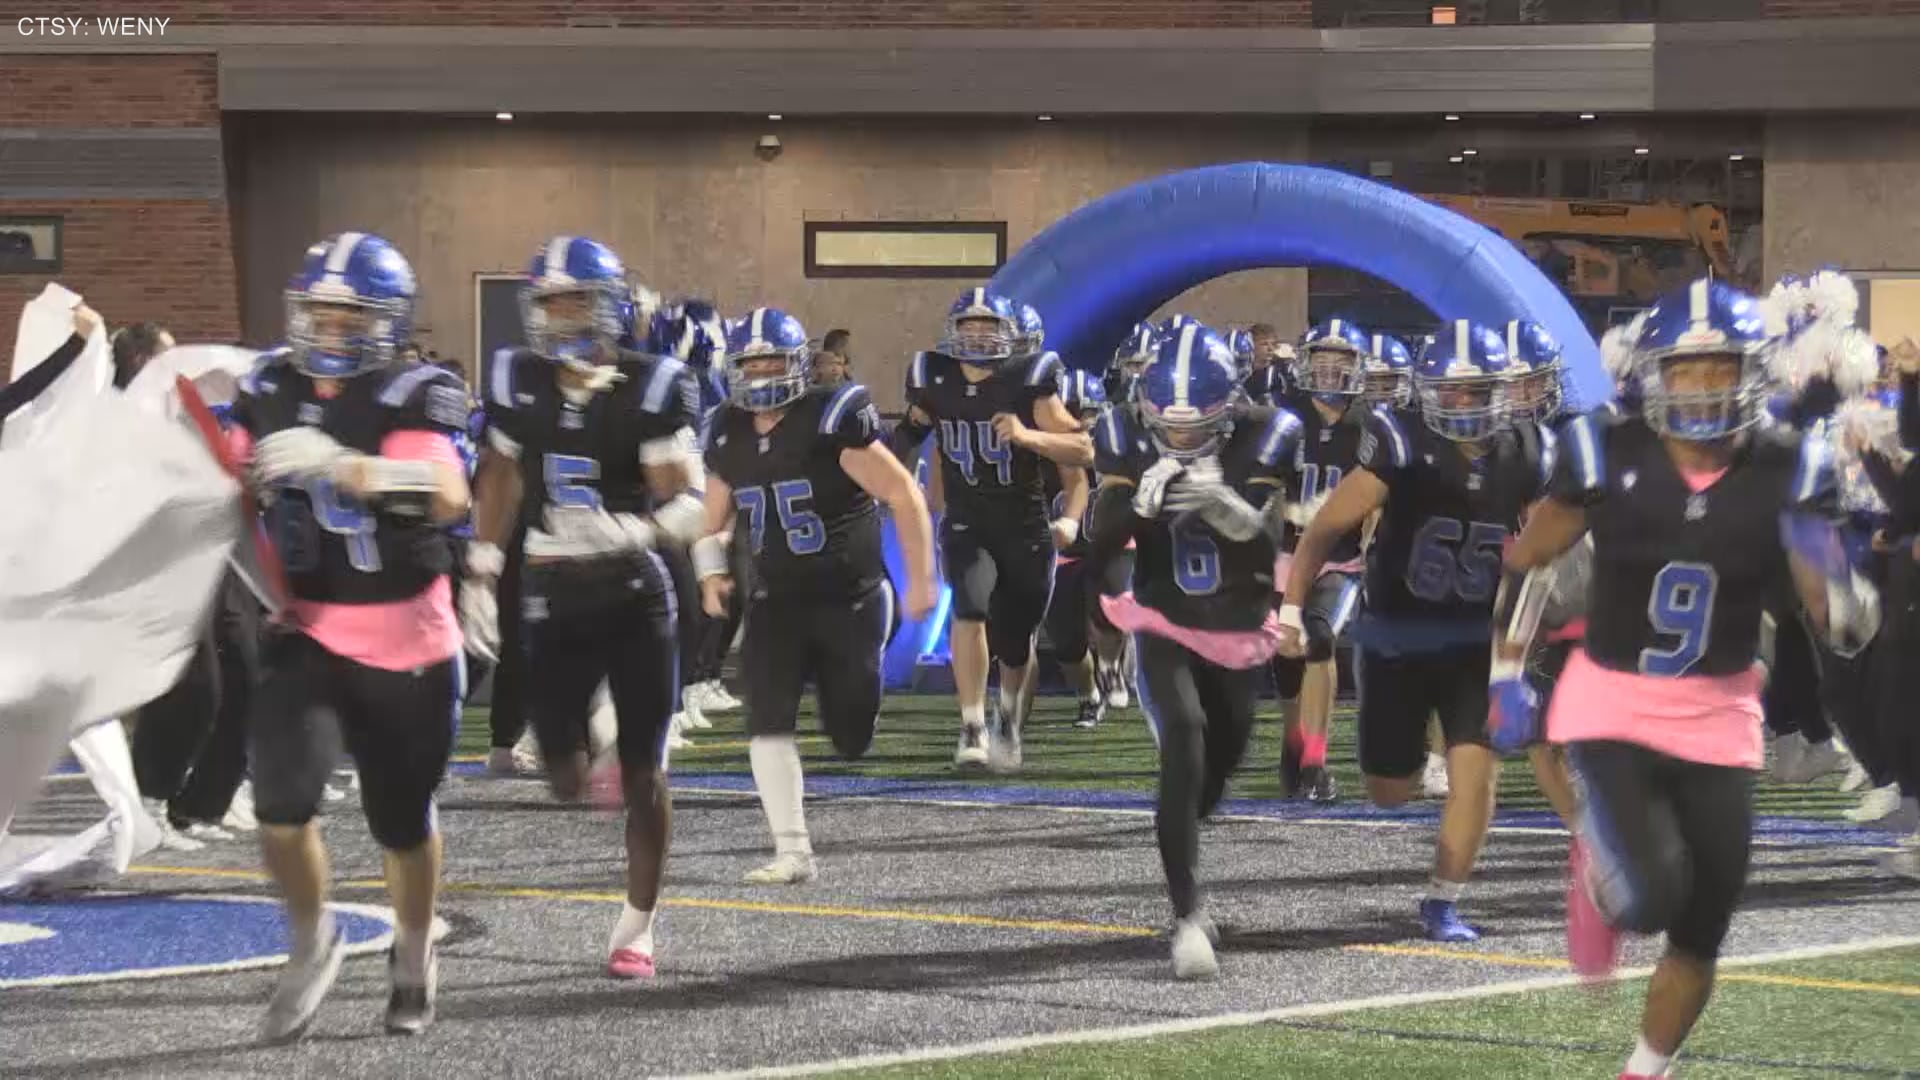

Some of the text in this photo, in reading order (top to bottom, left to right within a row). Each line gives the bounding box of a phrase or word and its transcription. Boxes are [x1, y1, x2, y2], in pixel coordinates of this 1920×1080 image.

[543, 453, 603, 513] 5
[940, 419, 1013, 486] 44
[733, 479, 826, 554] 75
[1168, 508, 1222, 594] 6
[1407, 516, 1505, 601] 65
[1638, 562, 1718, 678] 9
